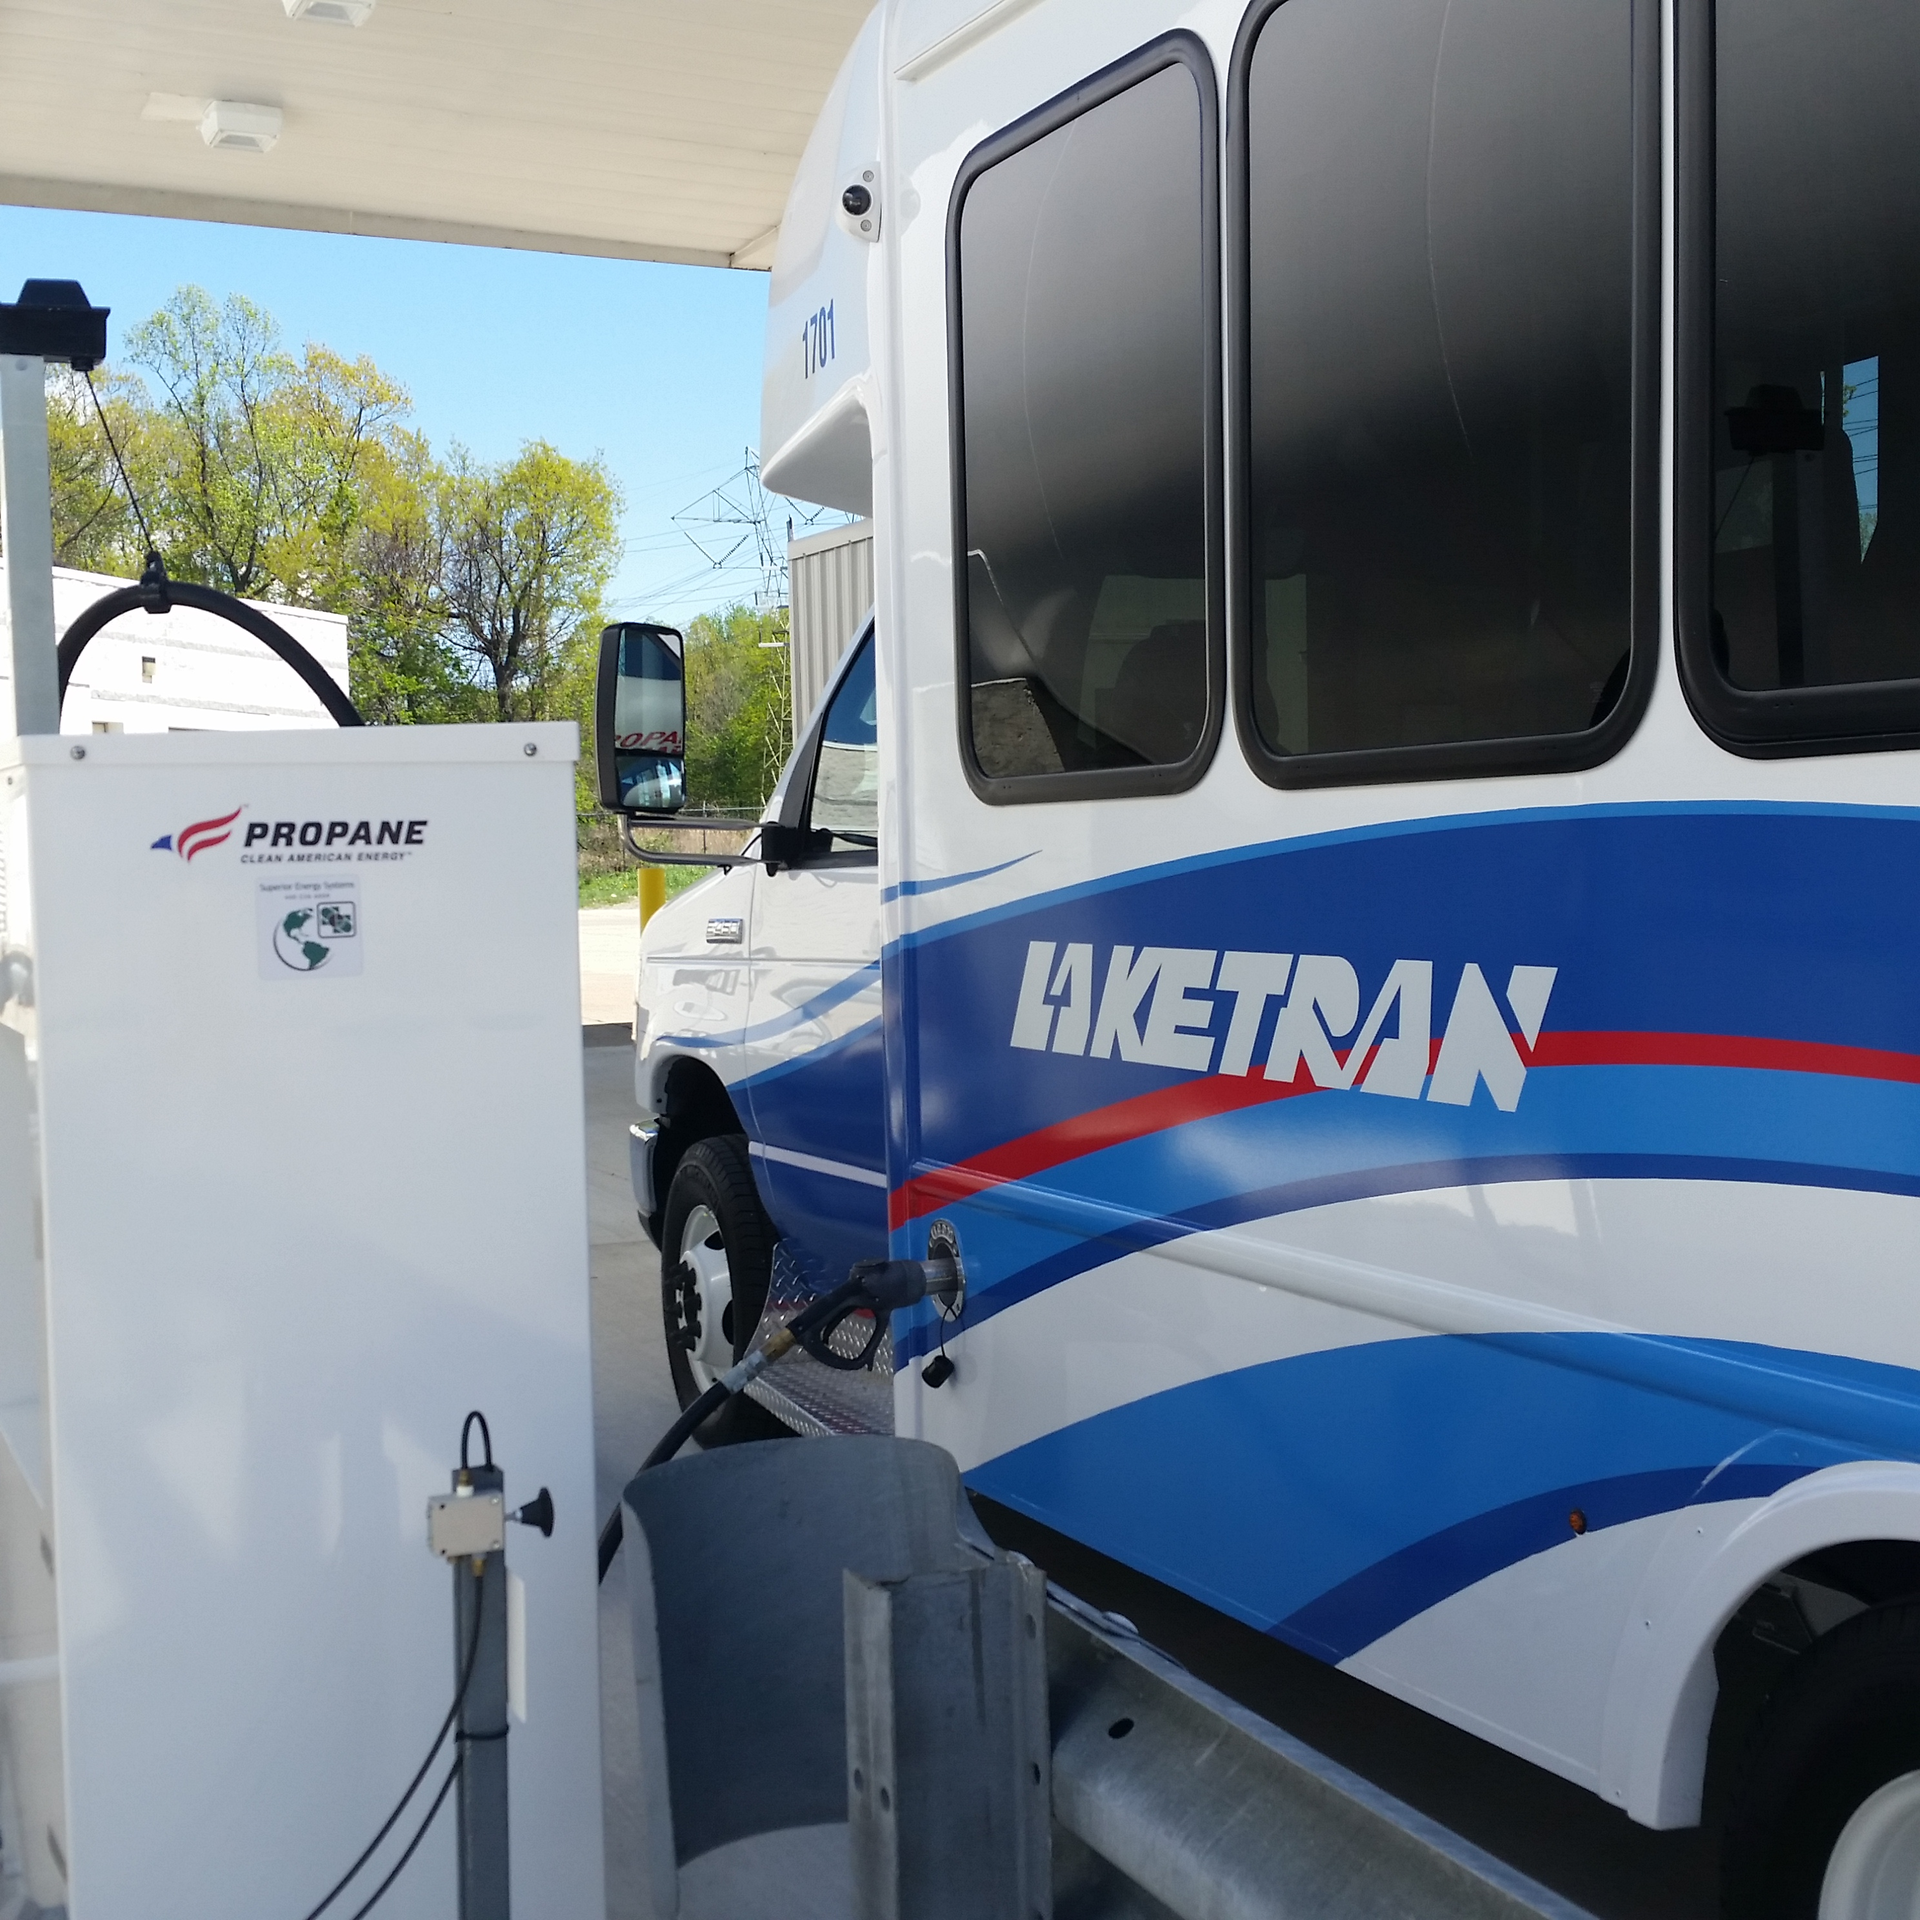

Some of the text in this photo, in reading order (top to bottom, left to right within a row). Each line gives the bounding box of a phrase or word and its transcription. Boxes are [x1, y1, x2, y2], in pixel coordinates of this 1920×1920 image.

[802, 298, 836, 380] 1701
[240, 854, 283, 864] CLEAN
[287, 852, 353, 863] AMERICAN
[244, 820, 428, 848] PROPANE
[1010, 940, 1558, 1112] LAKETRAN
